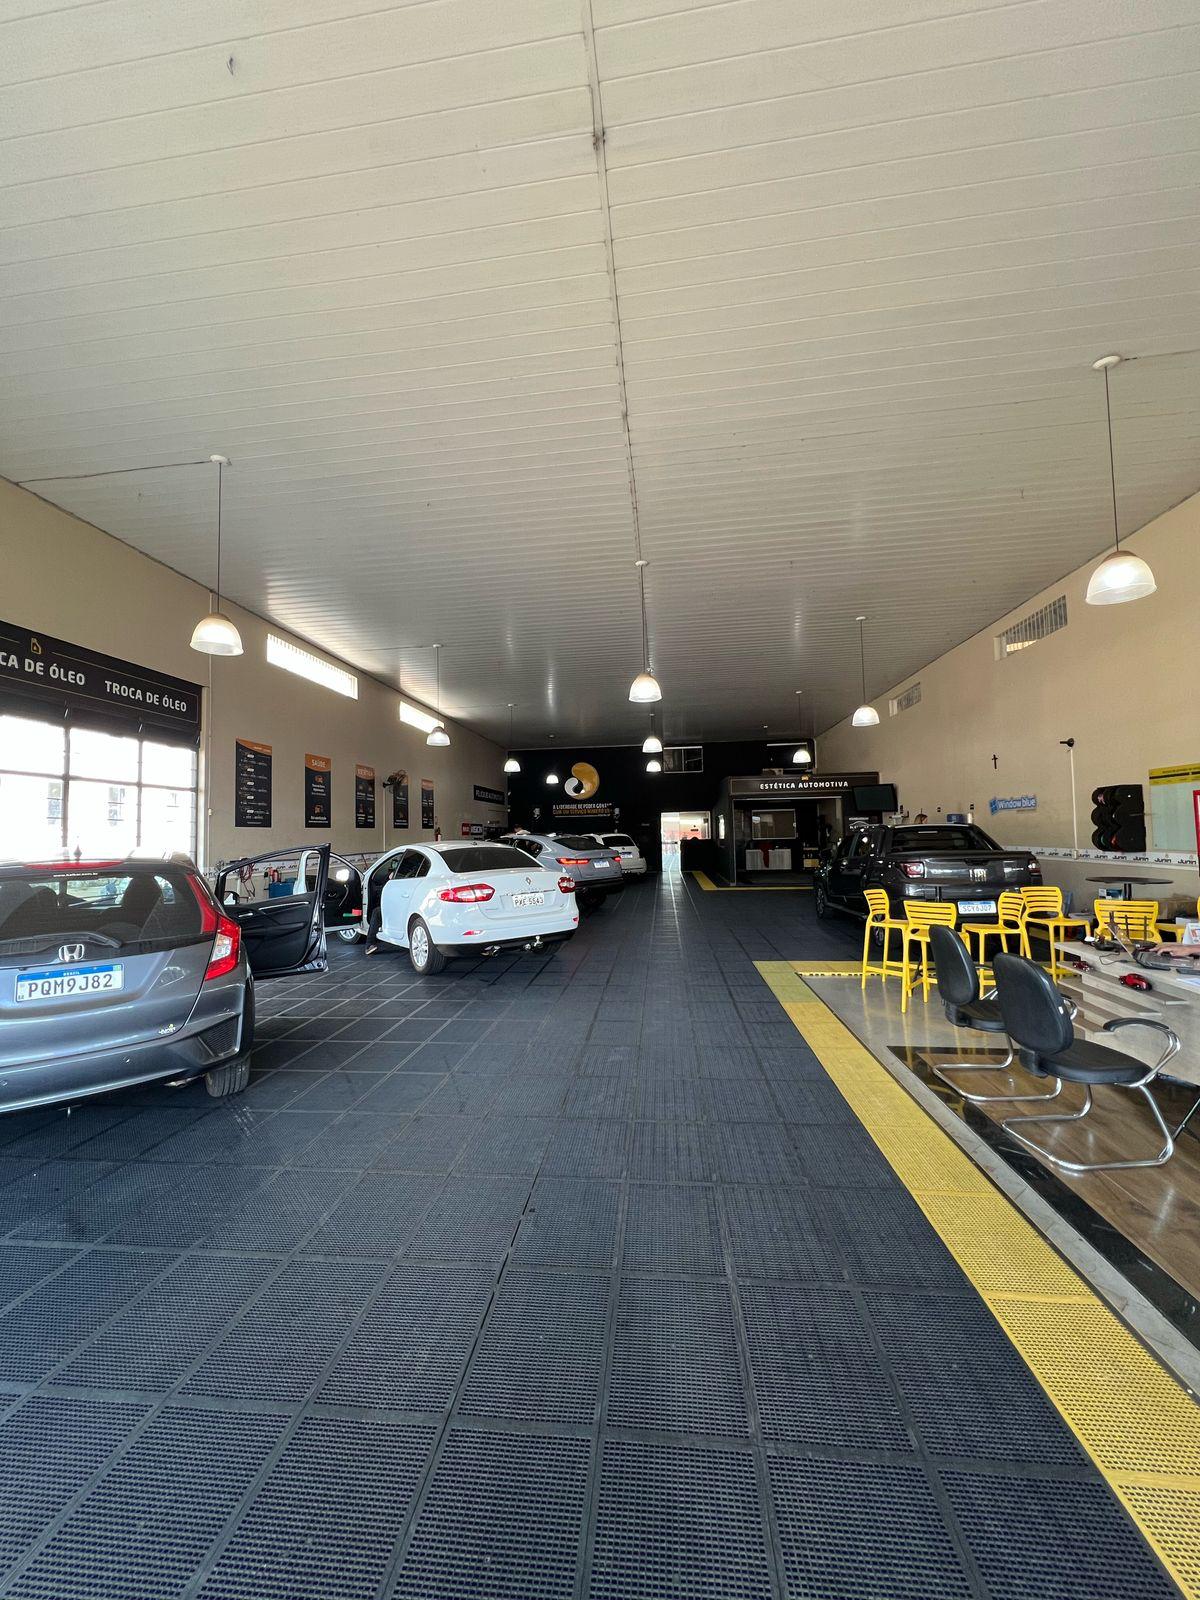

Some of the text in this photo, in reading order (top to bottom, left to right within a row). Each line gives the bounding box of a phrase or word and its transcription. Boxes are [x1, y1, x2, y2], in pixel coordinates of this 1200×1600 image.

[24, 659, 44, 675] DE
[50, 664, 85, 686] ÓLEO
[105, 681, 187, 712] TROCA DE ÓLEO
[760, 781, 849, 790] ESTÉTICA AUTOMOTIVA
[27, 974, 113, 997] PQM9J82
